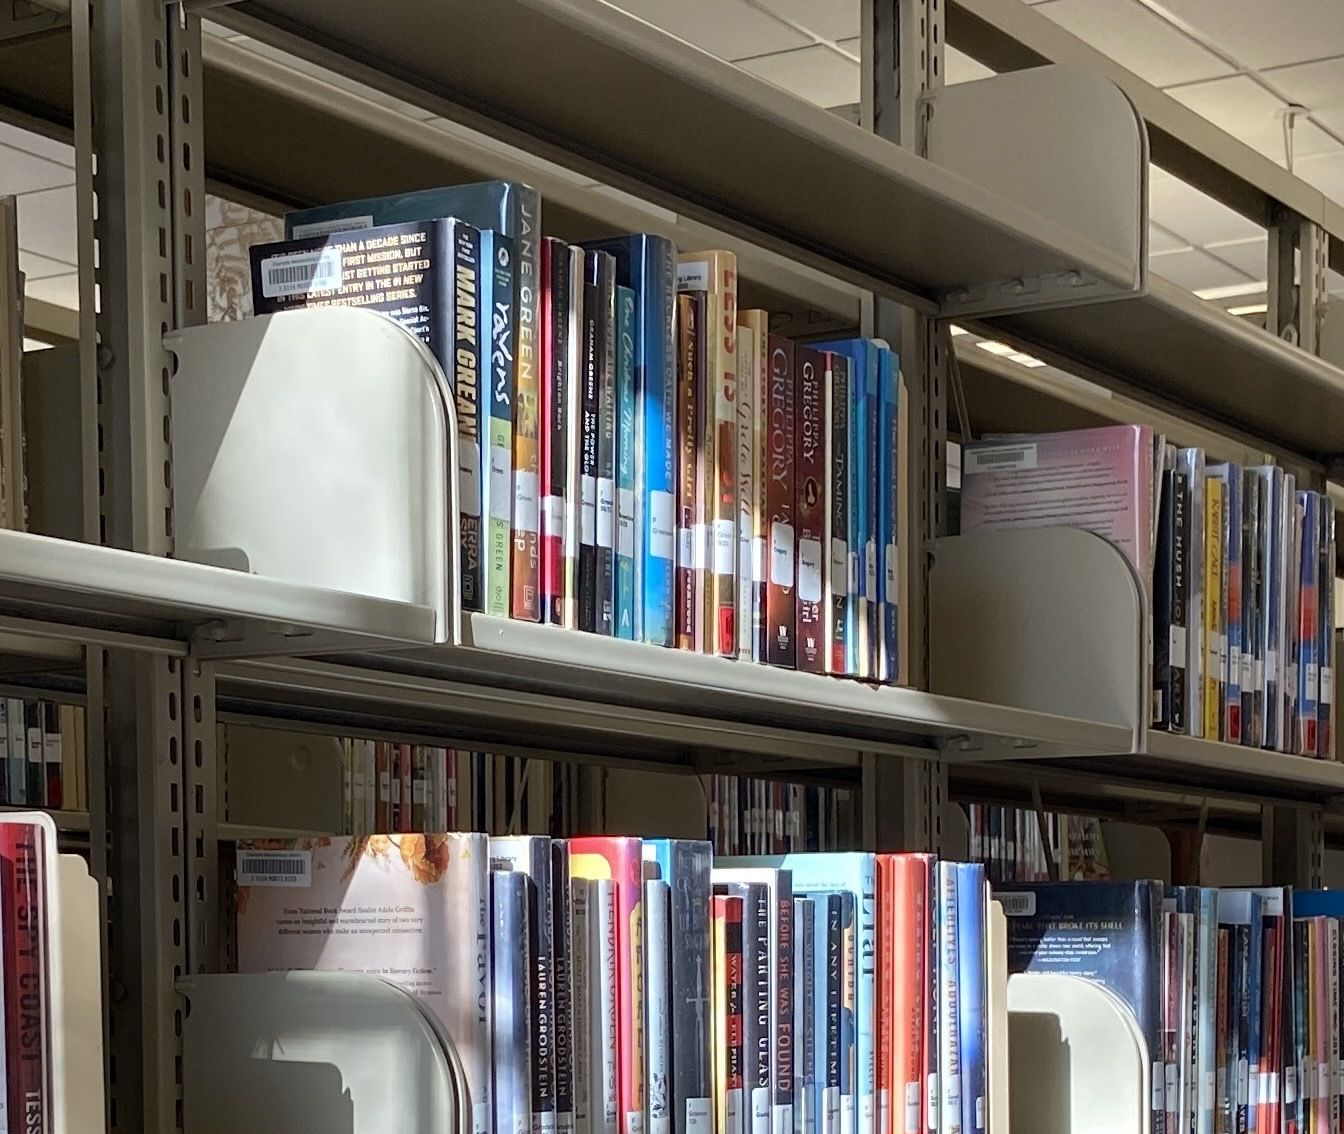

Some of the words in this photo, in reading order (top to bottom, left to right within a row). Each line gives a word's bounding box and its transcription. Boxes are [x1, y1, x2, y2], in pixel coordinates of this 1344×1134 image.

[342, 255, 366, 266] FIRST
[404, 246, 422, 257] BUT
[366, 236, 399, 250] DECADE
[400, 232, 426, 244] SINCE
[392, 260, 430, 272] STARTED
[519, 203, 533, 277] JANE
[403, 274, 424, 285] NEW
[455, 263, 477, 347] MARK
[491, 300, 514, 406] ravens
[518, 285, 533, 381] GREEN
[802, 361, 814, 465] GREGORY
[779, 899, 791, 953] BEFORE
[538, 1013, 550, 1099] GRODSTEIN
